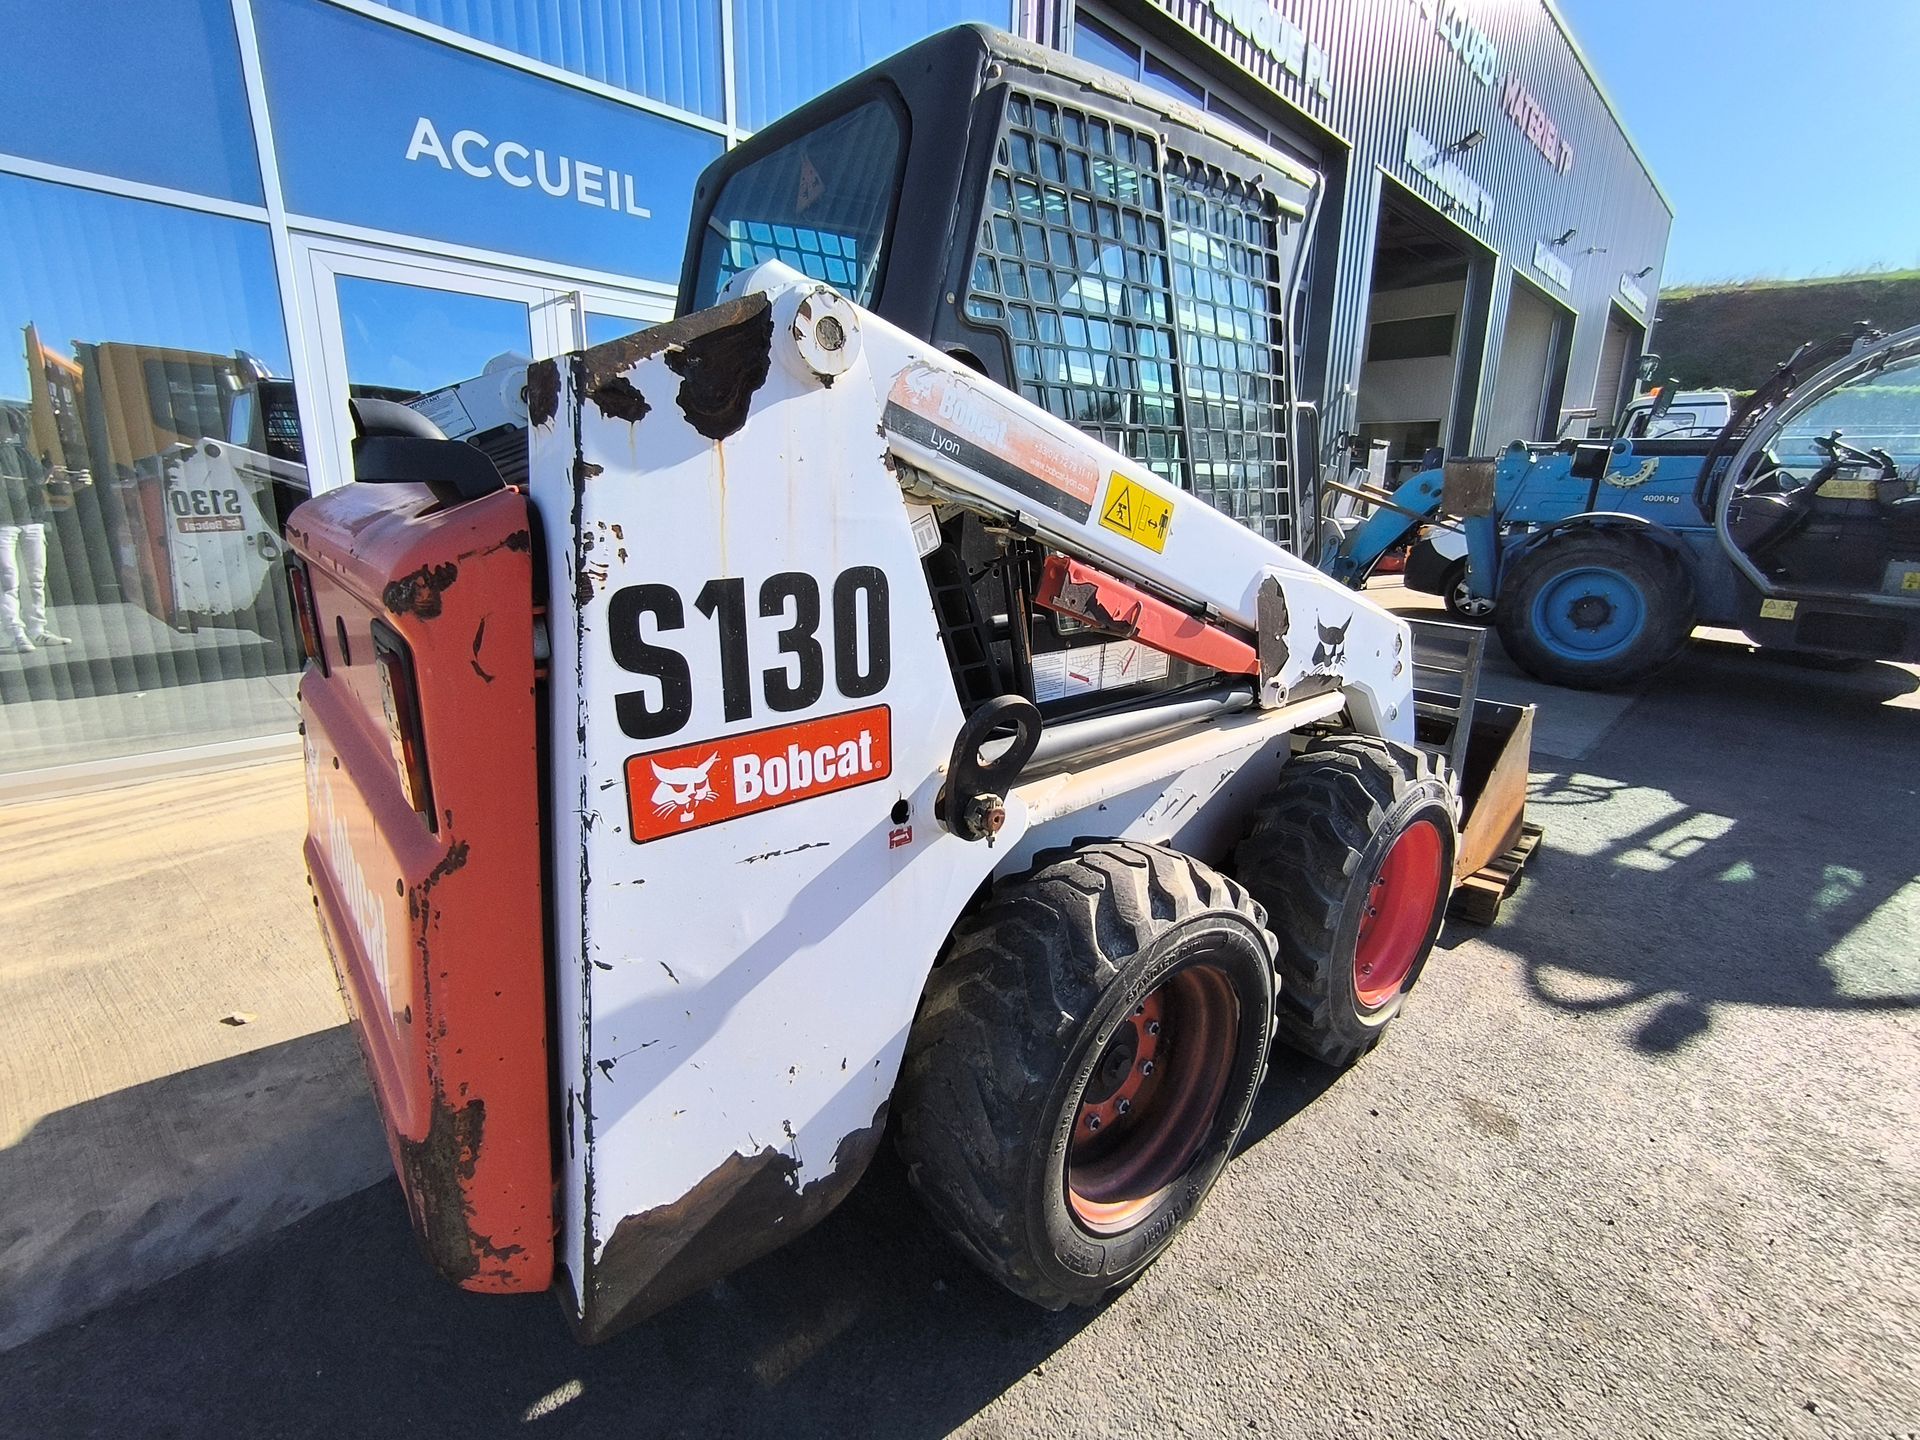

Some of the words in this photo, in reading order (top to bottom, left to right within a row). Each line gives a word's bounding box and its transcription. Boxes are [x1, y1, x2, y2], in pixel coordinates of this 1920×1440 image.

[405, 116, 652, 219] ACCUEIL
[930, 428, 961, 456] Lyon
[1642, 494, 1665, 502] 4000
[1666, 494, 1680, 504] Kg
[608, 565, 891, 740] S130
[731, 729, 874, 805] Bobcat
